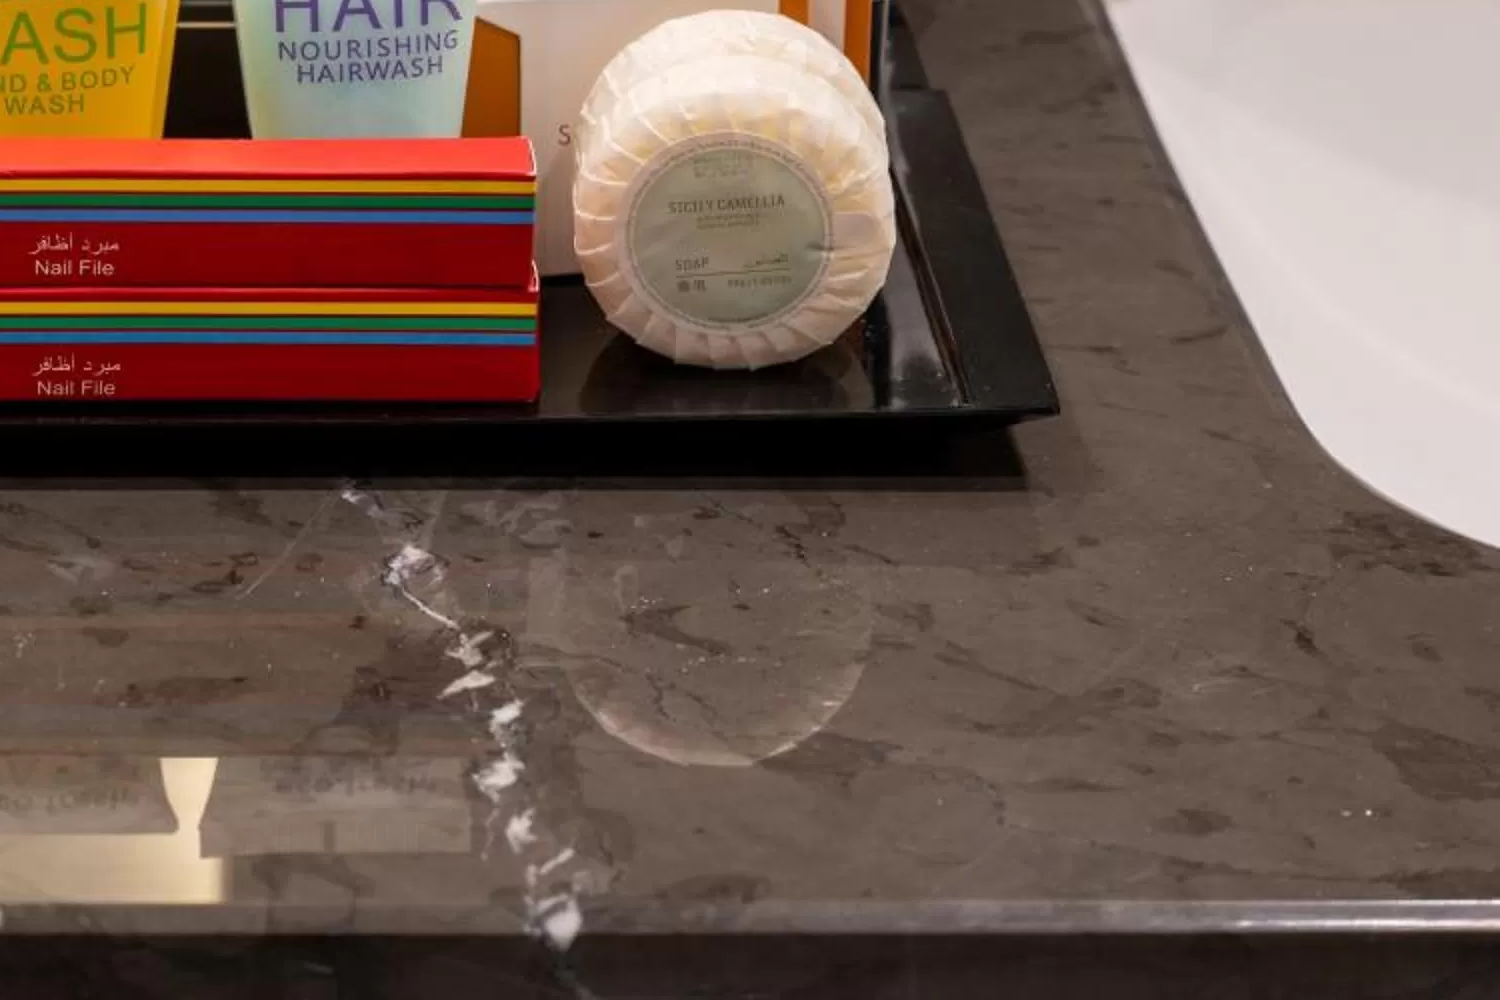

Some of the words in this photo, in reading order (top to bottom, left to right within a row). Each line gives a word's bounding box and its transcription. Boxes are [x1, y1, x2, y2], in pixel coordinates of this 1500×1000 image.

[278, 30, 458, 61] NOURISHING
[37, 72, 53, 91] &
[61, 66, 135, 91] BODY
[297, 55, 443, 85] HAIRWASH
[4, 95, 85, 116] WASH
[35, 259, 72, 276] Nail
[79, 259, 115, 276] File
[37, 379, 75, 396] Nail
[81, 379, 116, 396] File
